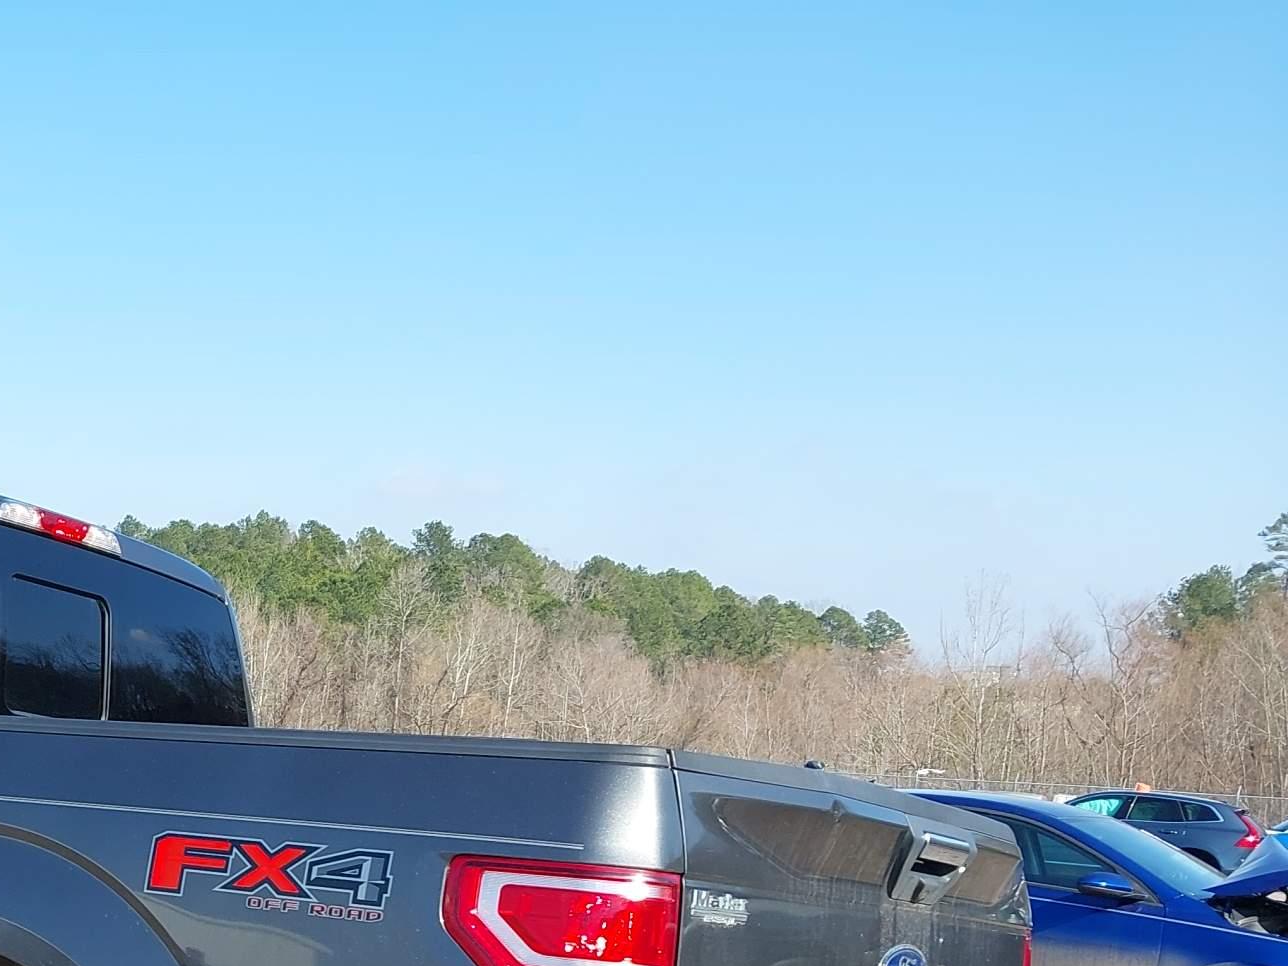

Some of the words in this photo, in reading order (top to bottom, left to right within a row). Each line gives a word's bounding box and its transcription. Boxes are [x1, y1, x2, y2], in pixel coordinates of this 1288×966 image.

[144, 830, 394, 910] FX4
[246, 896, 300, 912] OFF
[308, 903, 384, 922] ROAD
